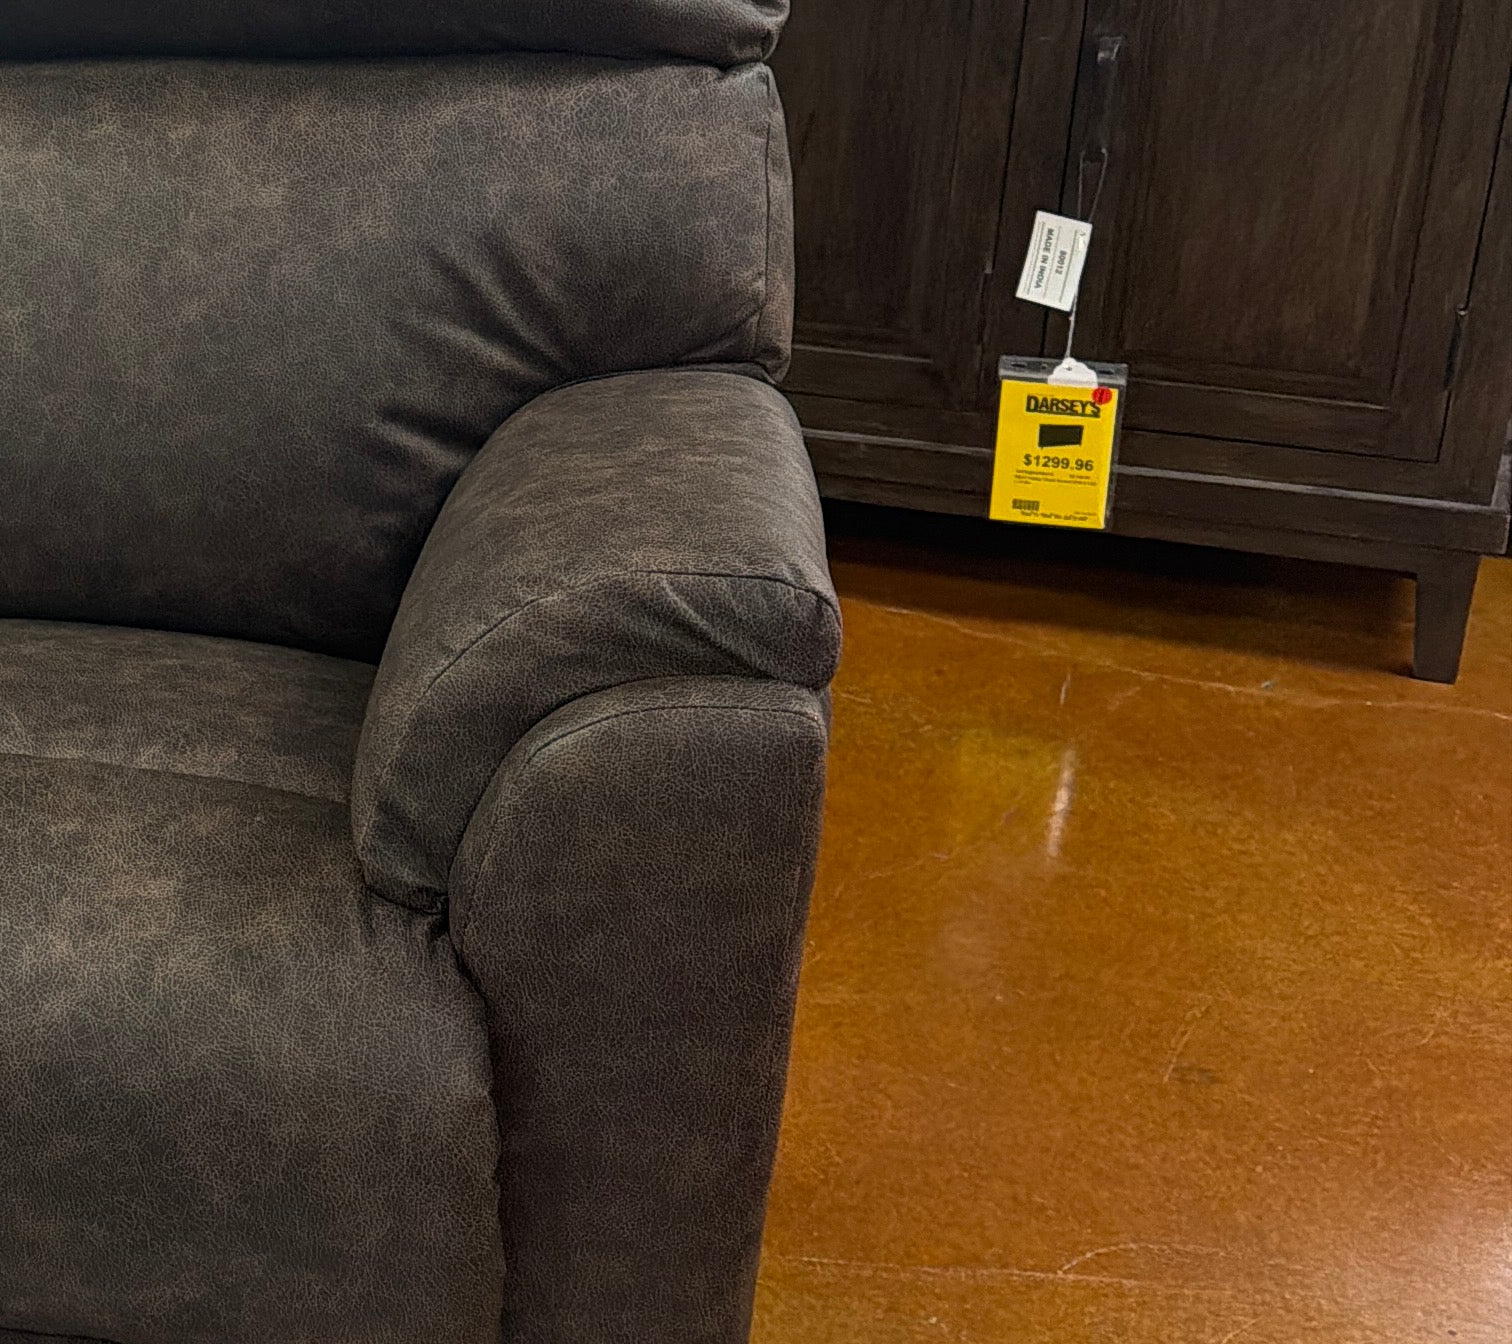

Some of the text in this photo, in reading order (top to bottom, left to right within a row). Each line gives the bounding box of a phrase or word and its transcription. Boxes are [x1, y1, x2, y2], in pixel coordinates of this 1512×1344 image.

[1034, 228, 1055, 289] MADE IN INDIA
[1023, 453, 1094, 472] $1299.96
